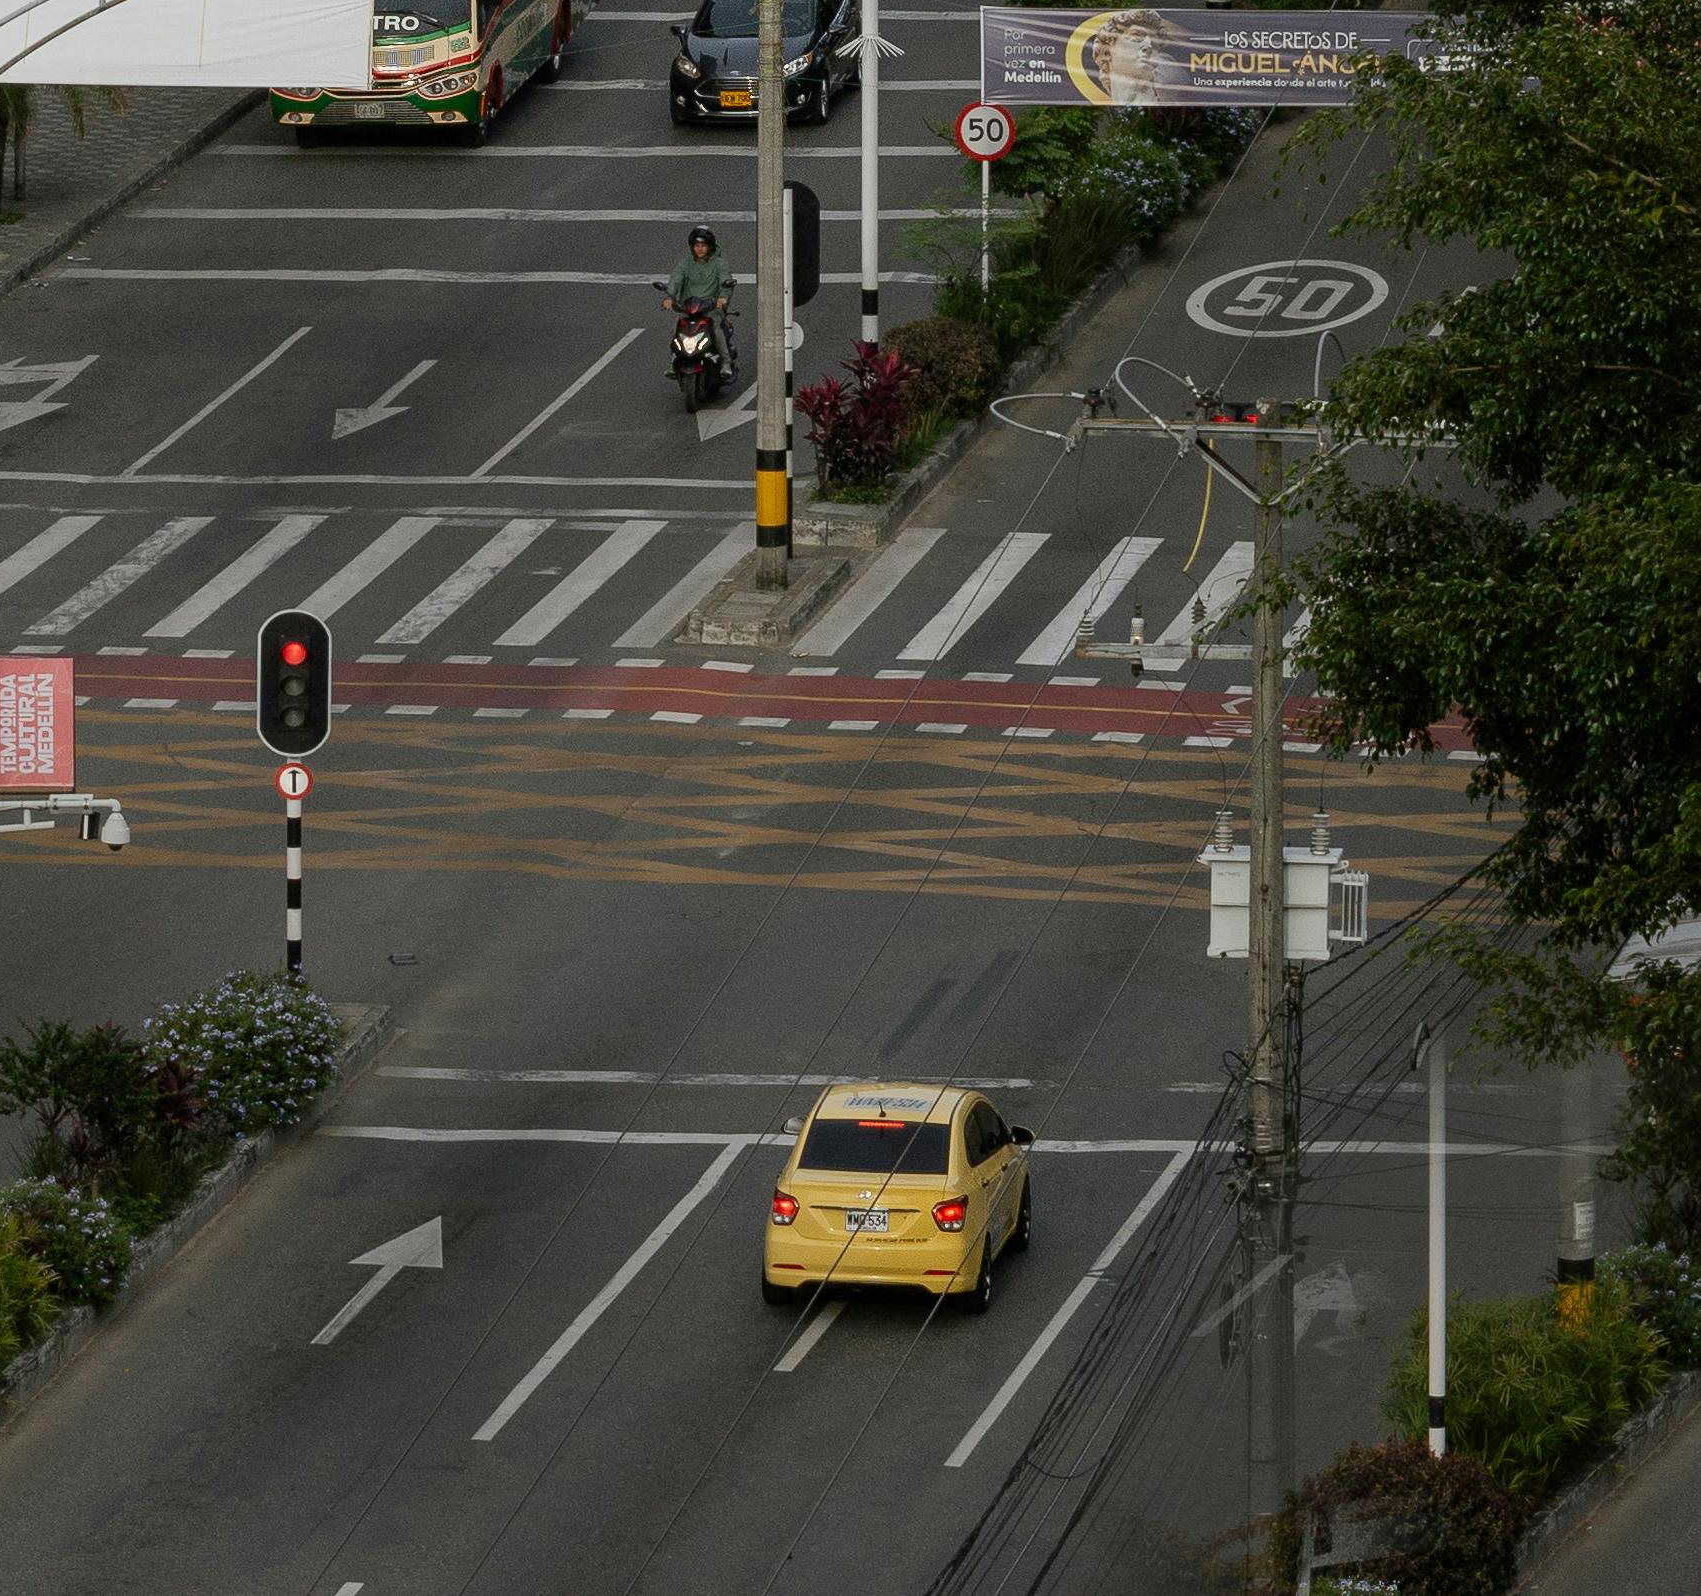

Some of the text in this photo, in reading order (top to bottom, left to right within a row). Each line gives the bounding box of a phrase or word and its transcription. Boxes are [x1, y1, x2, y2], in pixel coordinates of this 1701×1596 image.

[1004, 28, 1026, 40] Por
[1335, 32, 1358, 49] DE
[1004, 43, 1056, 57] primera
[1004, 59, 1046, 68] vez en
[1189, 52, 1290, 73] MIGUEL
[1004, 70, 1062, 83] Medellín
[1193, 77, 1213, 86] Una
[1215, 78, 1272, 88] experiencia
[1306, 78, 1316, 87] el
[1317, 79, 1336, 88] arte
[969, 118, 1003, 142] 50
[1223, 275, 1355, 320] 50
[0, 673, 17, 774] TEMPORADA
[18, 673, 36, 774] CULTURAL
[868, 1214, 887, 1226] 534
